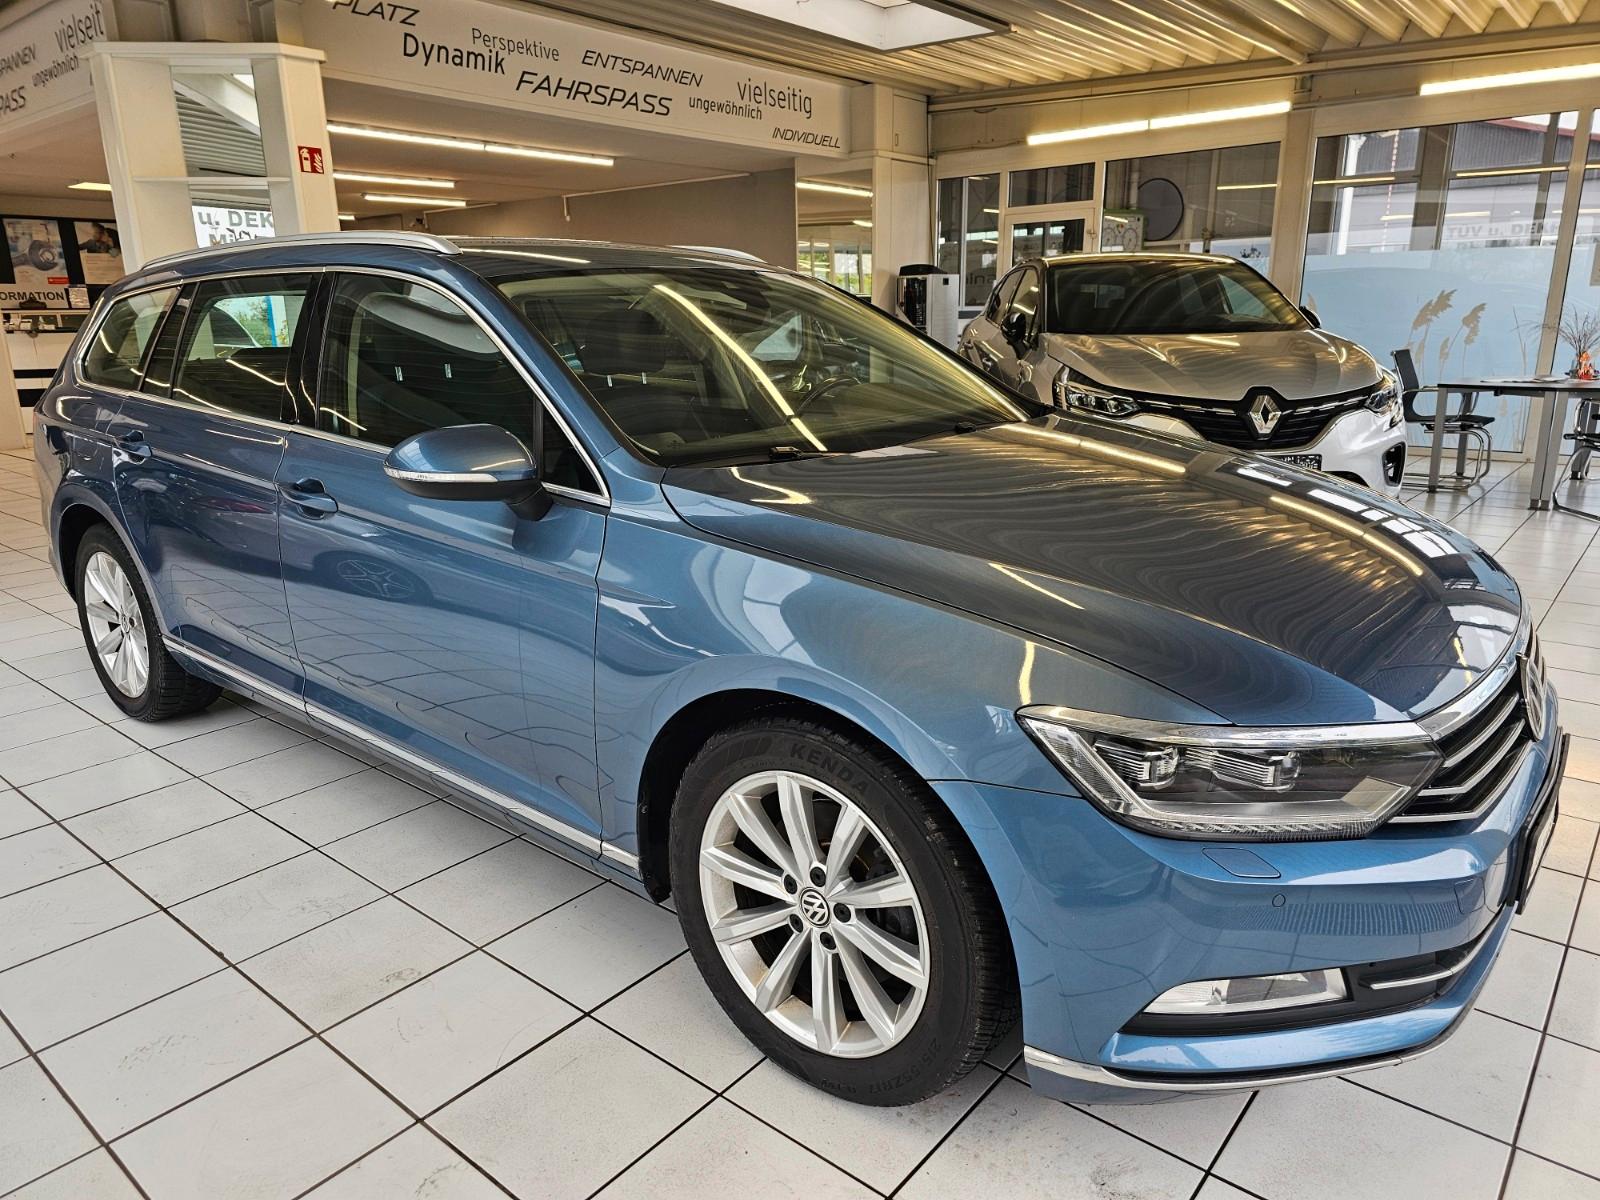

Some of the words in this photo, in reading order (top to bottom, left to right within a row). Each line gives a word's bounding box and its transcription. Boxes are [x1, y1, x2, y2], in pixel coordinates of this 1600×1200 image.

[403, 32, 506, 75] Dynamik
[471, 27, 561, 62] Perspektive
[581, 49, 704, 88] ENTSPANNEN
[515, 70, 673, 117] FAHRSPASS
[688, 96, 763, 121] ungewöhnlich
[736, 77, 813, 120] vielseitig
[771, 126, 841, 149] INDIVIDUELL
[197, 210, 220, 226] u.
[789, 742, 869, 794] KENDA
